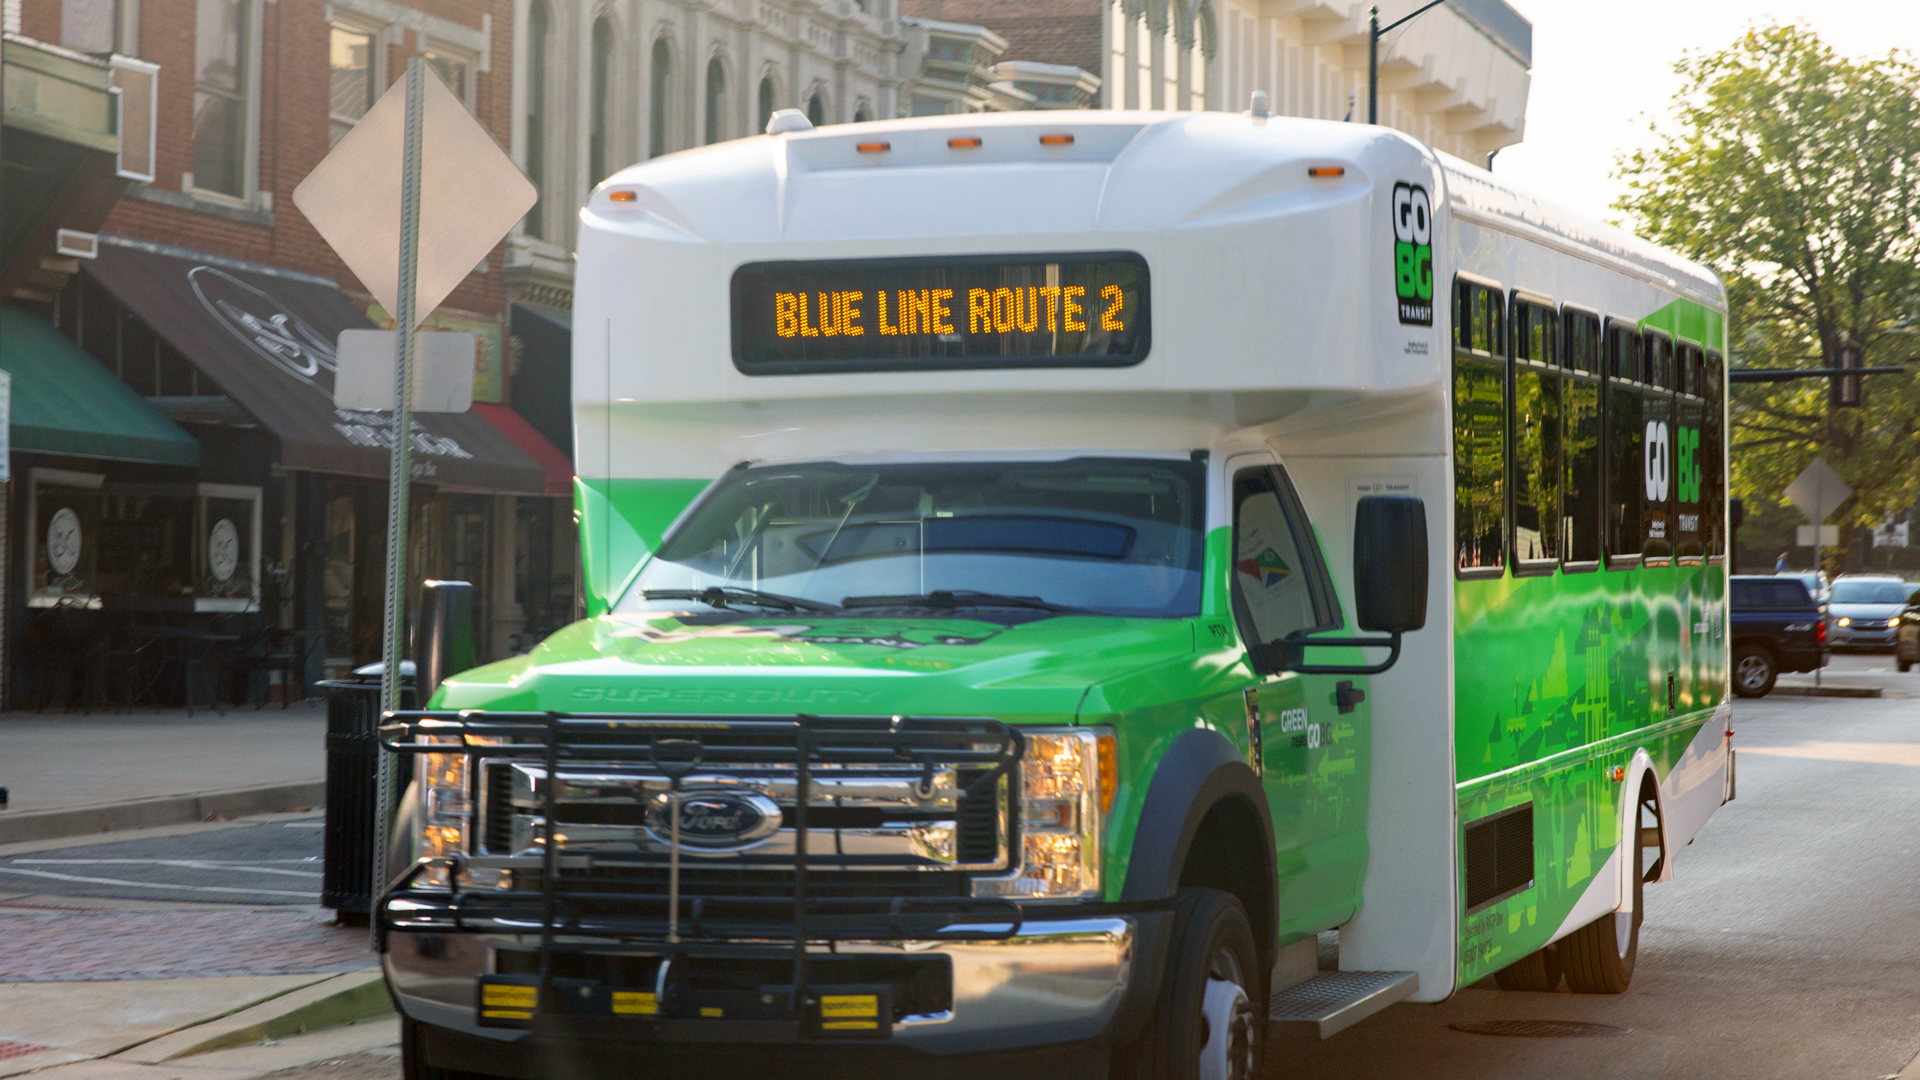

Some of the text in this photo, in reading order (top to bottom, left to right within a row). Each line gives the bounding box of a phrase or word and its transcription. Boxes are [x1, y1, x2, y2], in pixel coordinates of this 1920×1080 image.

[1394, 186, 1431, 246] GO
[1396, 240, 1433, 300] BG
[775, 284, 1124, 338] BLUE LINE ROUTE 2
[1400, 303, 1432, 322] TRANSIT
[1644, 419, 1700, 504] GO BG
[571, 687, 884, 703] SUPER DUTY
[1281, 708, 1307, 732] GREEN
[677, 800, 744, 831] Ford
